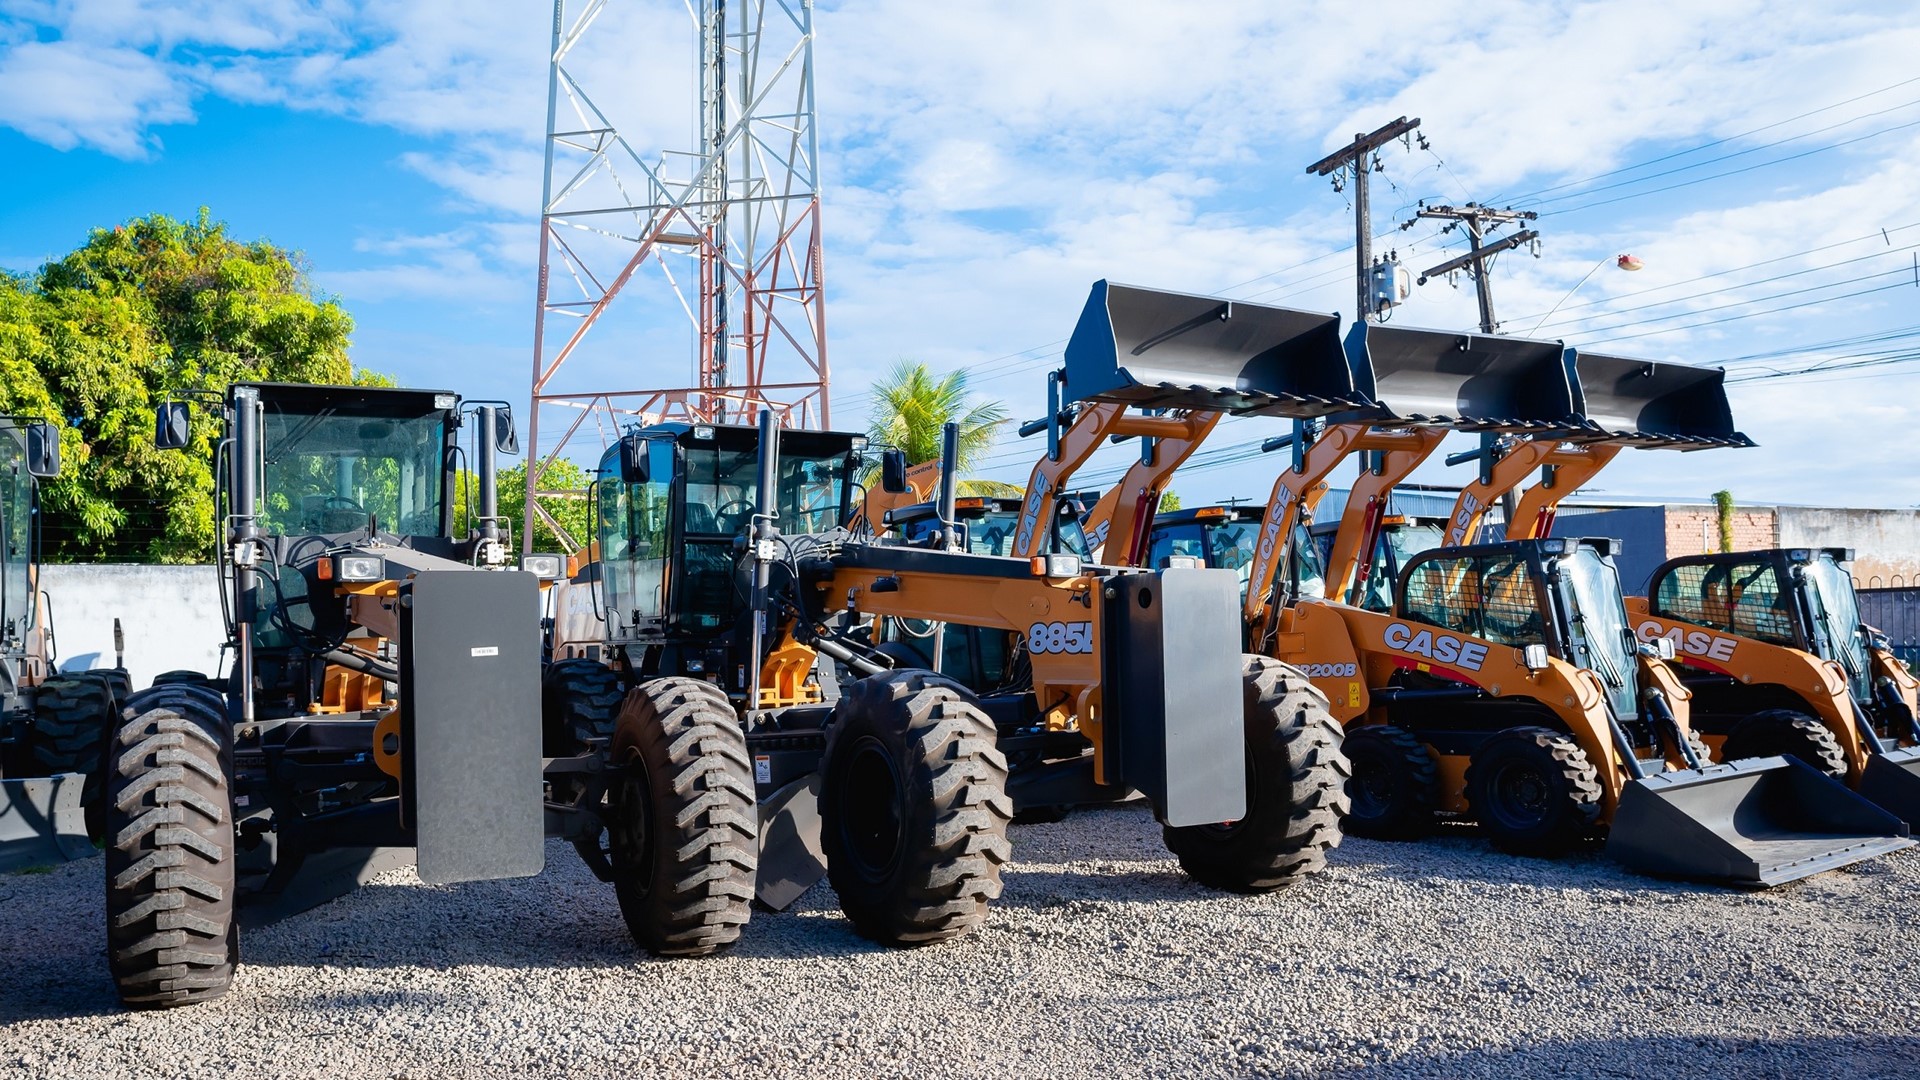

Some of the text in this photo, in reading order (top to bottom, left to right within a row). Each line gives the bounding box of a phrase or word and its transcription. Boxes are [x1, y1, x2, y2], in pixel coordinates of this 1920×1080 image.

[911, 464, 933, 476] control
[1017, 469, 1048, 556] CASE
[1260, 482, 1292, 560] CASE
[1445, 491, 1479, 547] ASE
[1383, 622, 1490, 672] CASE
[1636, 620, 1739, 663] CASE
